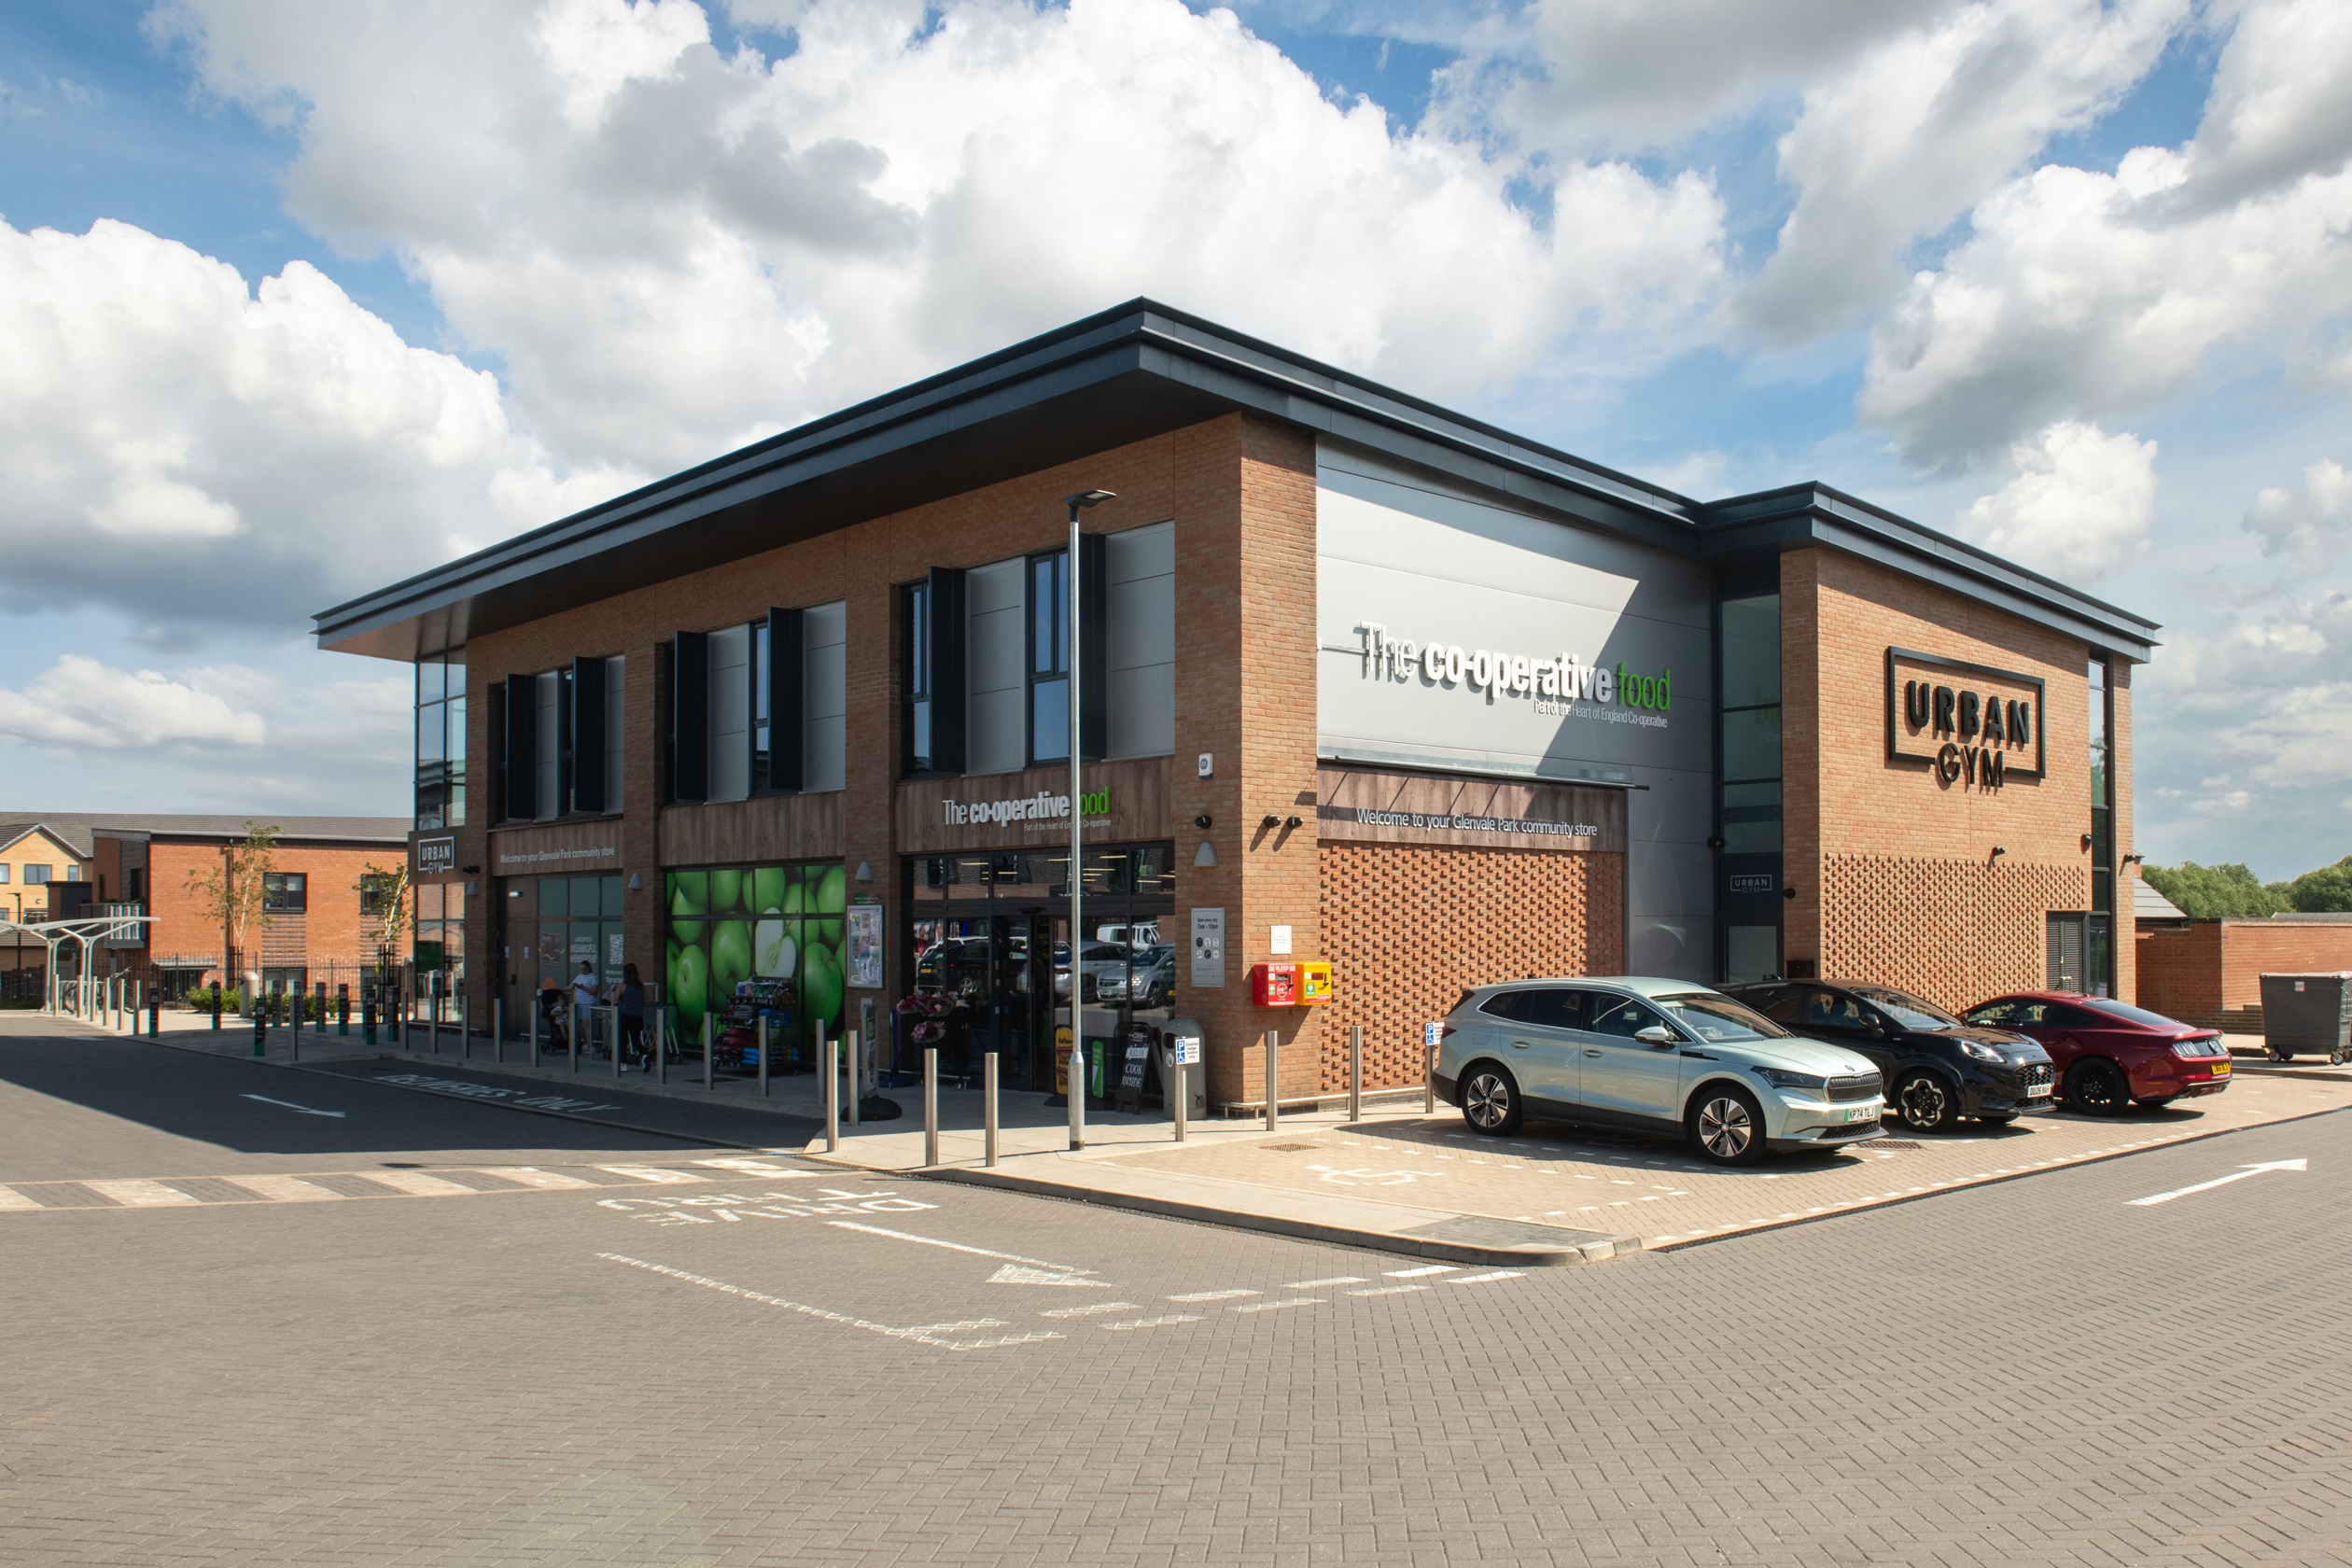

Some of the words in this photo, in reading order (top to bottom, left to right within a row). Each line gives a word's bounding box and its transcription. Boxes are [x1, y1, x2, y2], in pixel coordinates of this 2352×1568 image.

[1359, 621, 1418, 678] The
[1424, 642, 1612, 702] co-operative
[1618, 662, 1671, 710] food
[1534, 699, 1550, 714] Part
[1550, 700, 1559, 715] of
[1559, 702, 1572, 716] the
[1573, 704, 1592, 718] Heart
[1592, 707, 1601, 719] of
[1602, 707, 1628, 723] England
[1628, 711, 1668, 728] Co-operative
[1908, 680, 2029, 744] URBAN
[1935, 743, 2004, 787] GYM
[943, 800, 968, 825] The
[970, 791, 1071, 827] co-operative
[1079, 785, 1110, 815] ood
[1024, 822, 1033, 832] Part
[1046, 821, 1058, 830] Heart
[1357, 807, 1409, 826] Welcome
[1411, 812, 1424, 827] to
[1426, 815, 1449, 832] your
[1452, 815, 1495, 832] Glenvale
[1498, 817, 1519, 833] Park
[1521, 820, 1573, 838] community
[1575, 823, 1597, 836] store
[422, 846, 451, 861] URBAN
[500, 853, 521, 863] Welcome
[522, 853, 527, 861] to
[527, 853, 539, 863] your
[539, 849, 560, 861] Glenvale
[560, 848, 571, 859] Park
[572, 847, 601, 860] community
[601, 847, 615, 856] store
[427, 861, 444, 875] GYM
[1735, 878, 1768, 887] URBAN
[1126, 1063, 1143, 1074] COOK
[1122, 1076, 1142, 1087] INSIDE
[513, 1096, 623, 1113] ONLY
[595, 1188, 898, 1211] THRU
[625, 1198, 941, 1226] DRIVE
